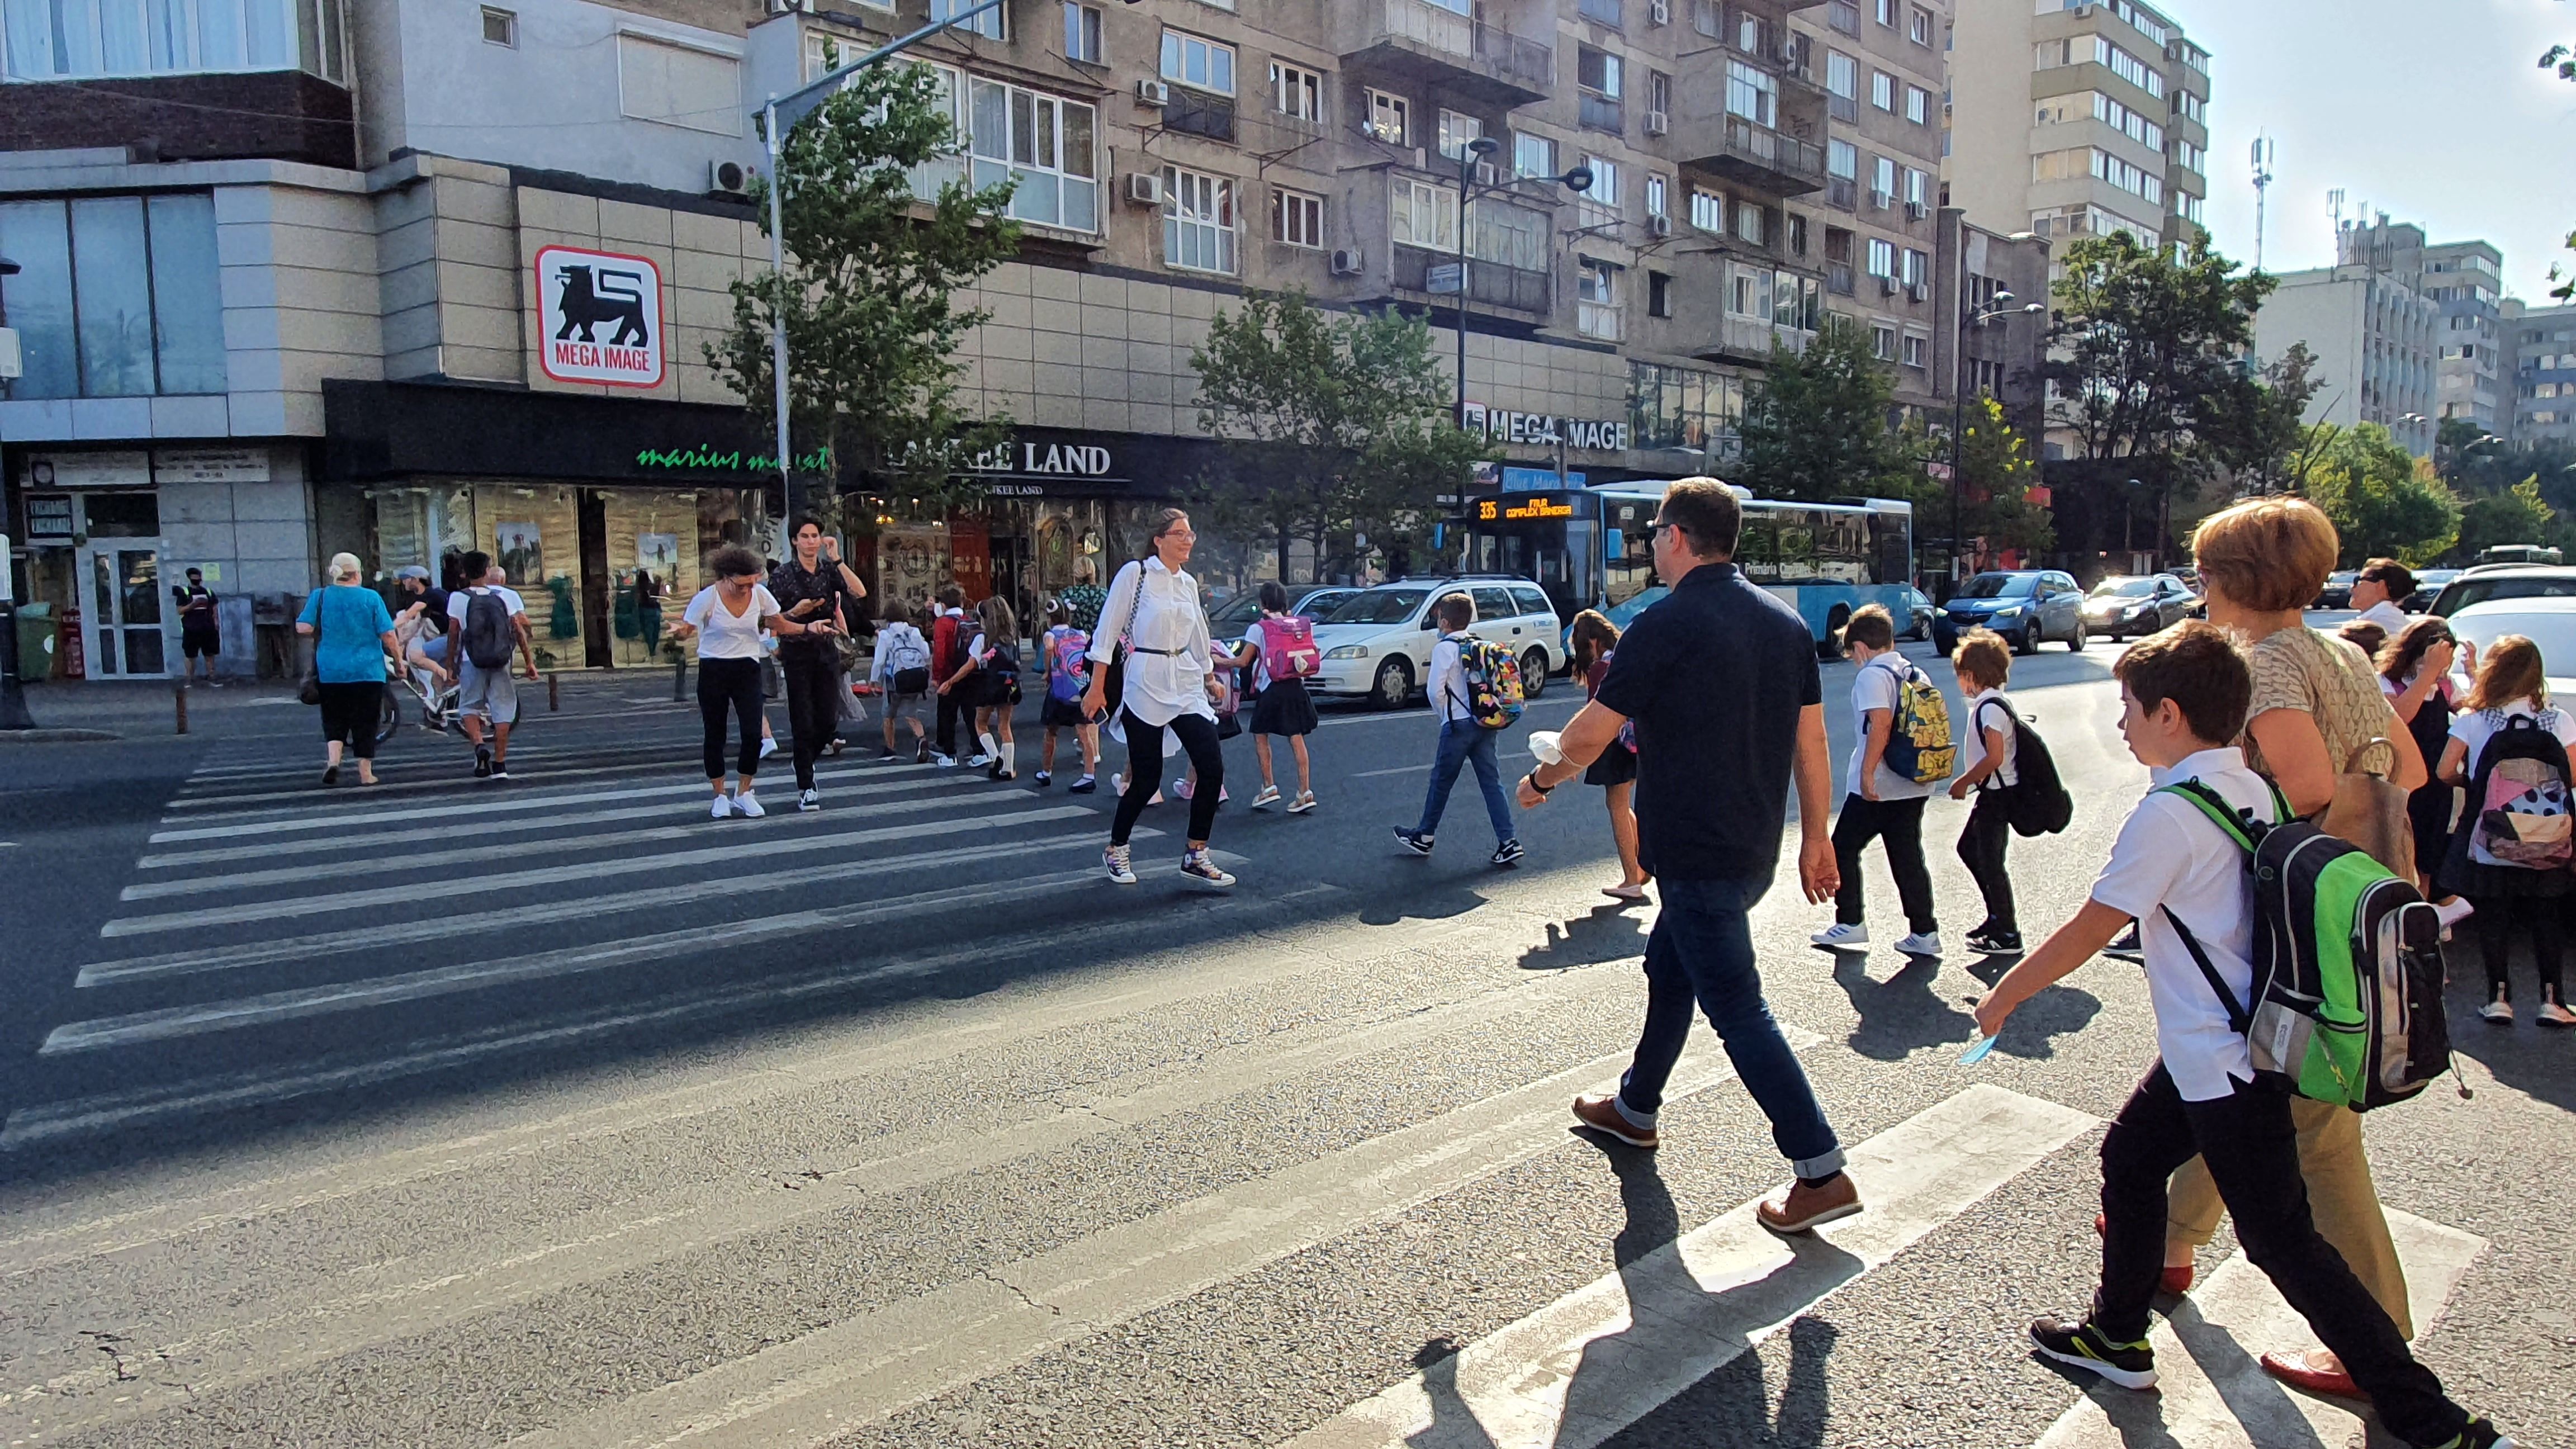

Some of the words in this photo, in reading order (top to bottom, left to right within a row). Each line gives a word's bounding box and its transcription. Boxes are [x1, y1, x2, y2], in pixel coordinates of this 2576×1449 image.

[556, 343, 601, 367] MEGA
[604, 347, 650, 372] IMAGE
[1491, 409, 1559, 446] MEGA
[1564, 418, 1628, 451] MAGE
[636, 443, 740, 471] marius
[747, 446, 828, 473] muat
[1023, 443, 1111, 475] LAND
[1016, 485, 1043, 495] LAND
[1480, 501, 1497, 519] 335
